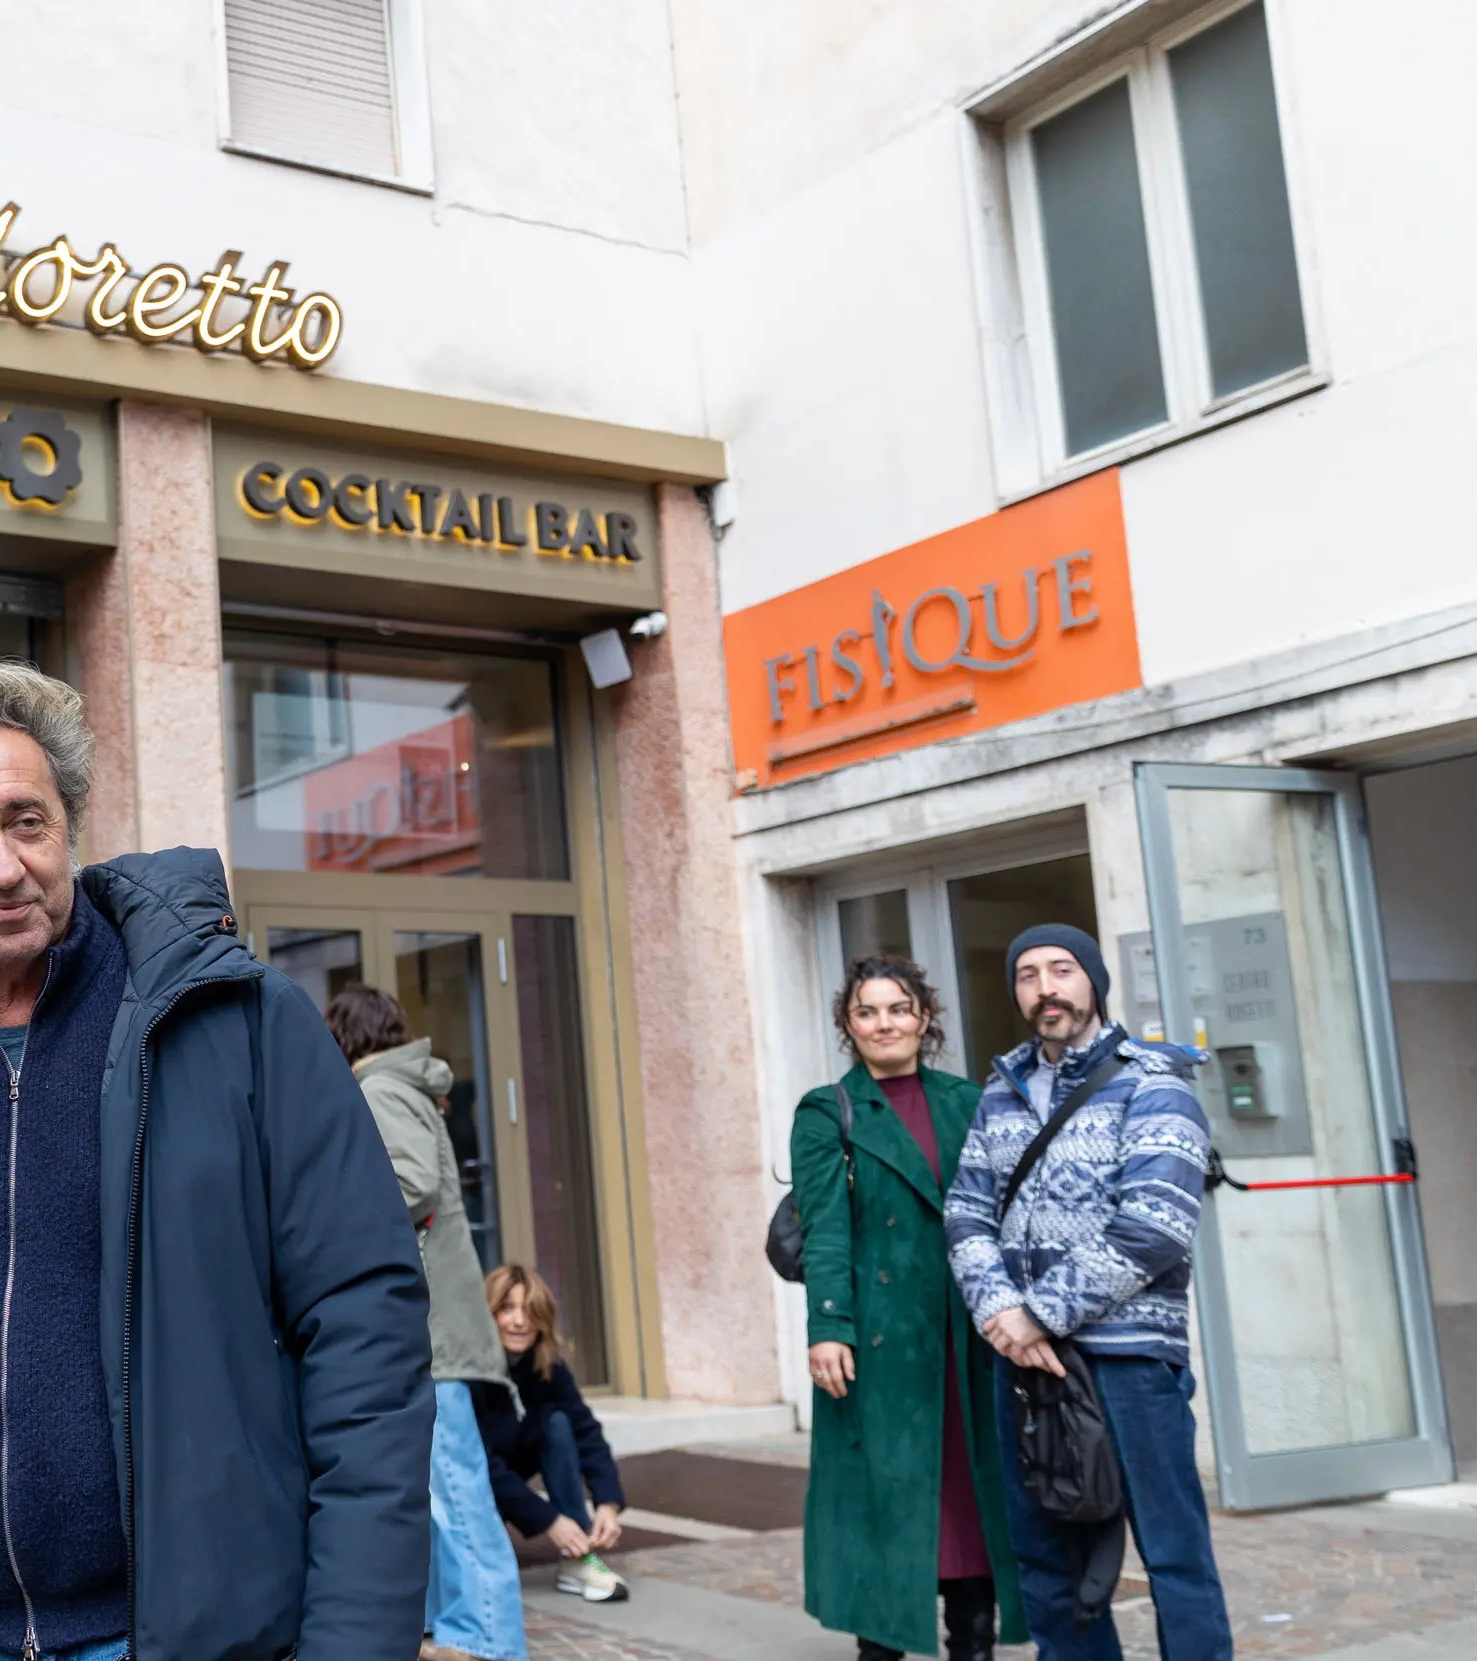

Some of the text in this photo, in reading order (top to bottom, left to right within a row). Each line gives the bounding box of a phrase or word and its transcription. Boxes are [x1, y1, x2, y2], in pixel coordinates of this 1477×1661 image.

[241, 460, 642, 562] COCKTAIL BAR
[763, 547, 1099, 724] FISIQUE
[1242, 927, 1268, 947] 73
